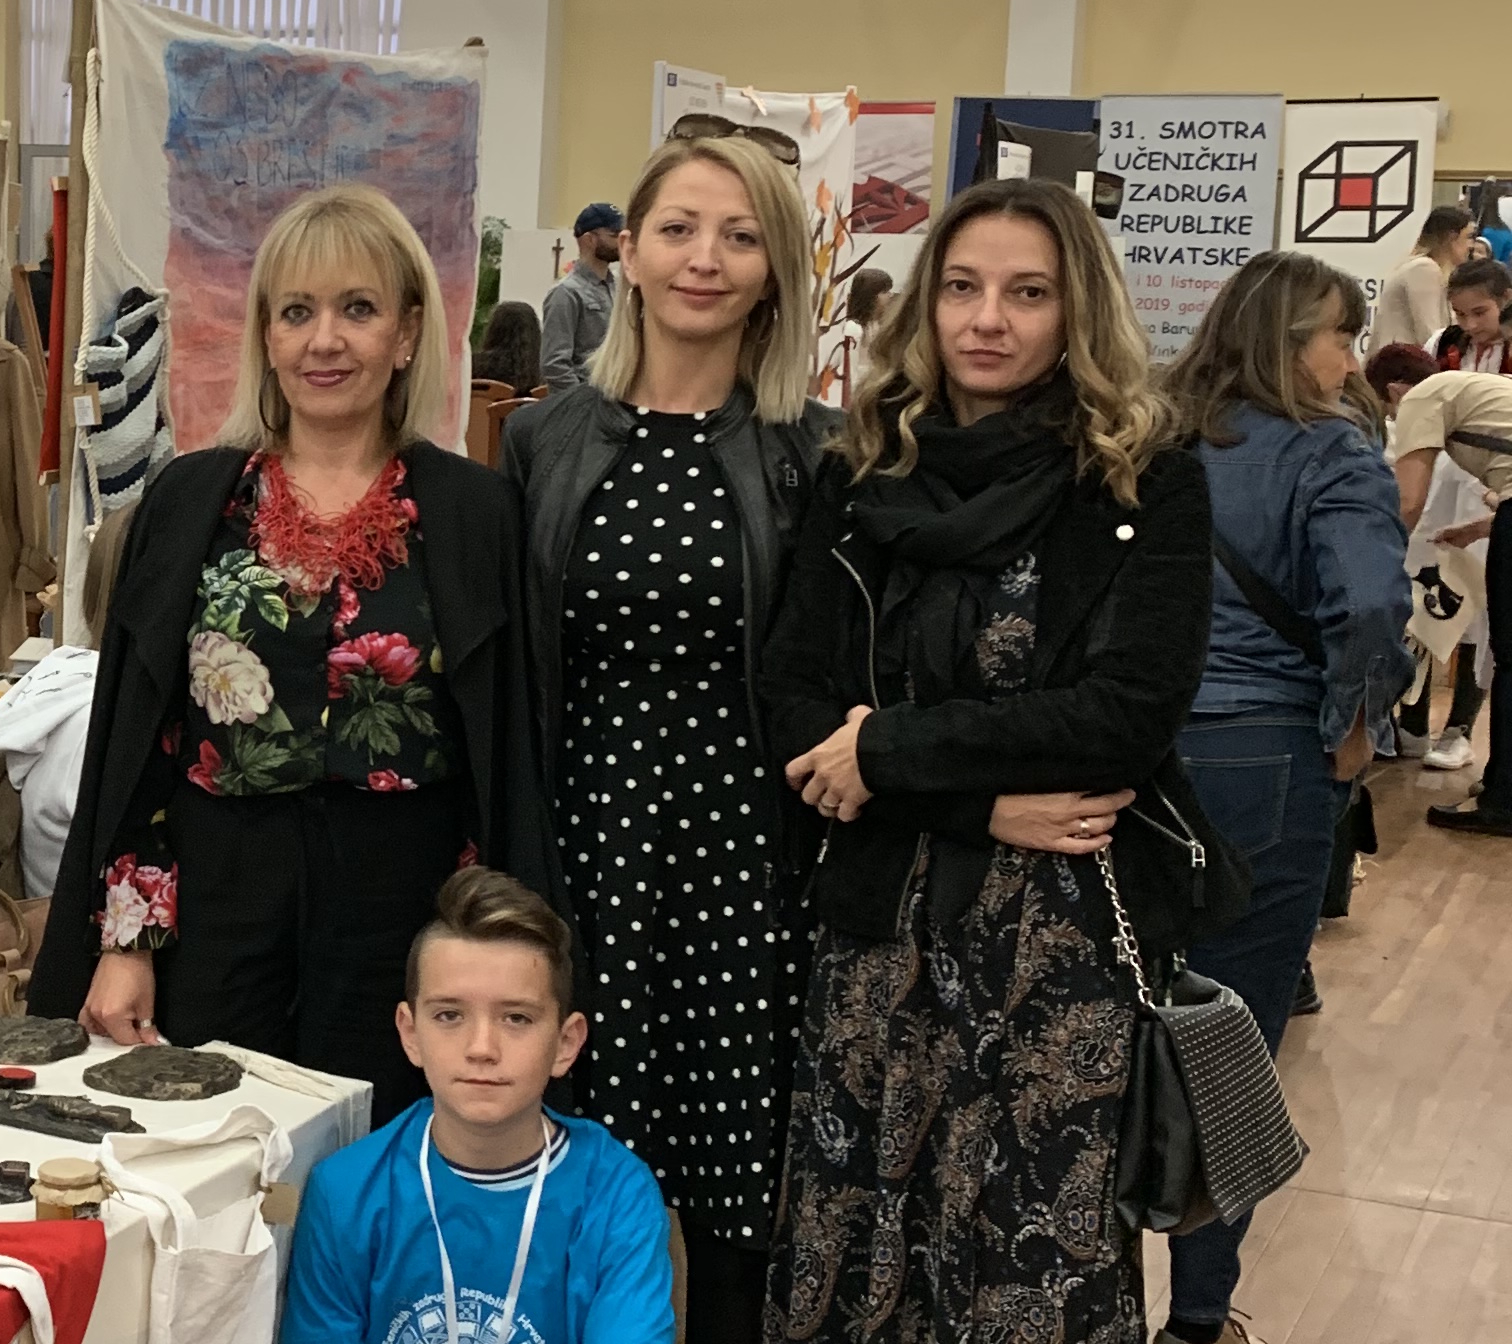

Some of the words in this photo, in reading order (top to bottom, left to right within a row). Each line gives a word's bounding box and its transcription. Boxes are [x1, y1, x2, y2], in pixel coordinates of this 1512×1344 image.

[1109, 120, 1145, 140] 31.
[1159, 120, 1267, 140] SMOTRA
[1114, 146, 1258, 172] UČENIČKIH
[1128, 183, 1248, 203] ZADRUGA
[1120, 214, 1254, 235] REPUBLIKE
[1124, 245, 1251, 266] HRVATSKE
[1146, 275, 1162, 288] 10
[1170, 275, 1226, 293] listopa
[460, 1287, 506, 1311] Republi
